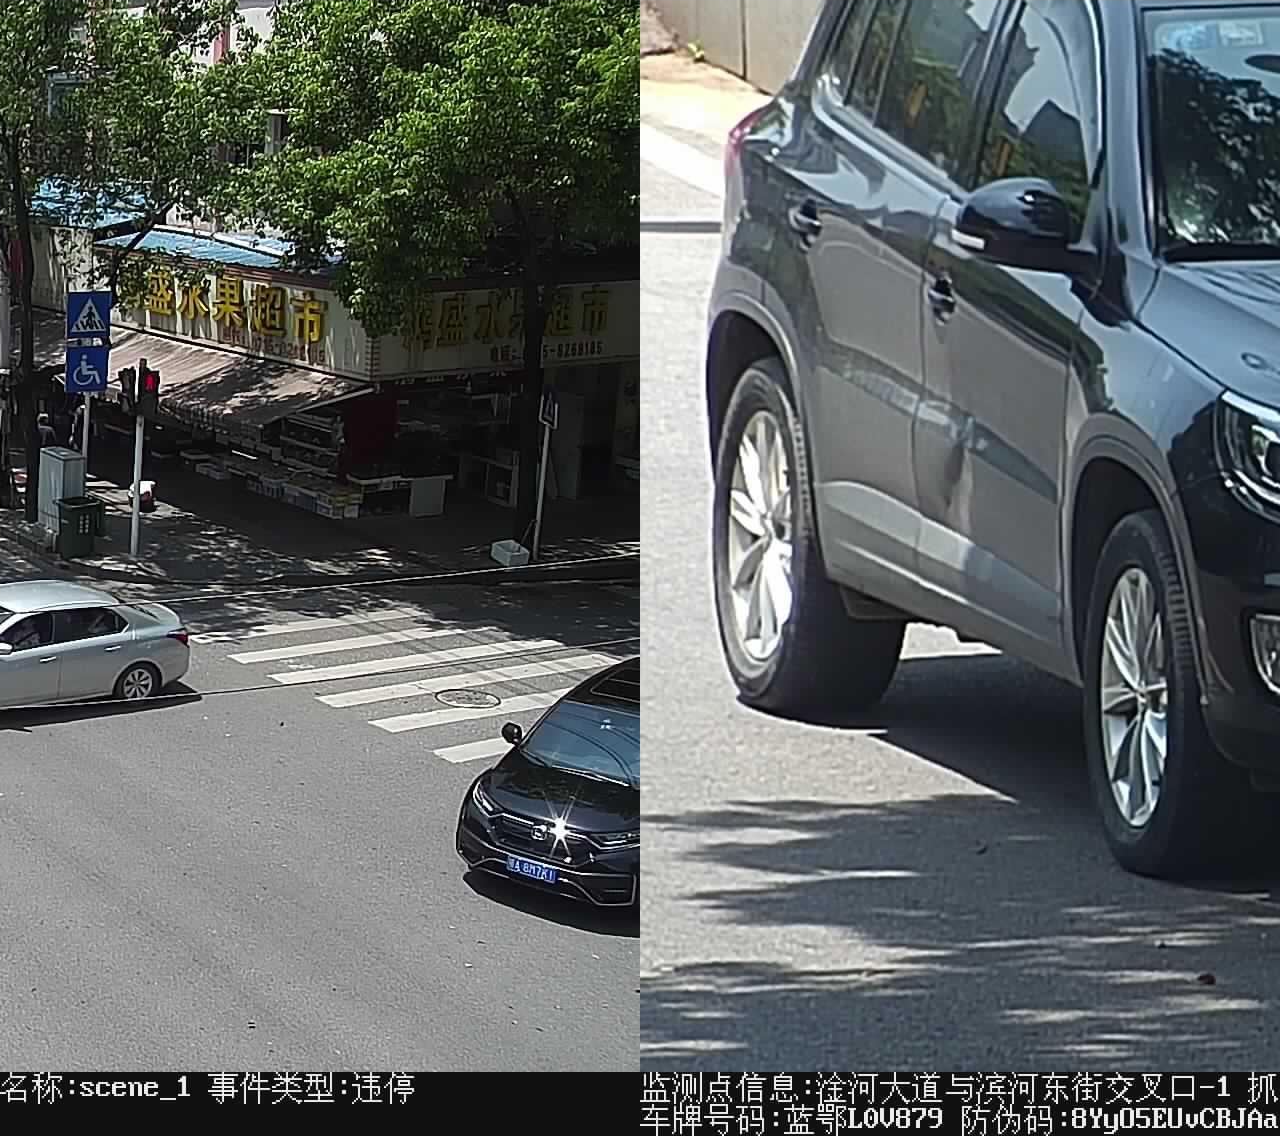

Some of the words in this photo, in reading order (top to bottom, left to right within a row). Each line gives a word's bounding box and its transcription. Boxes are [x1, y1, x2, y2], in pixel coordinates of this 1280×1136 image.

[129, 268, 327, 343] 盛水果超市
